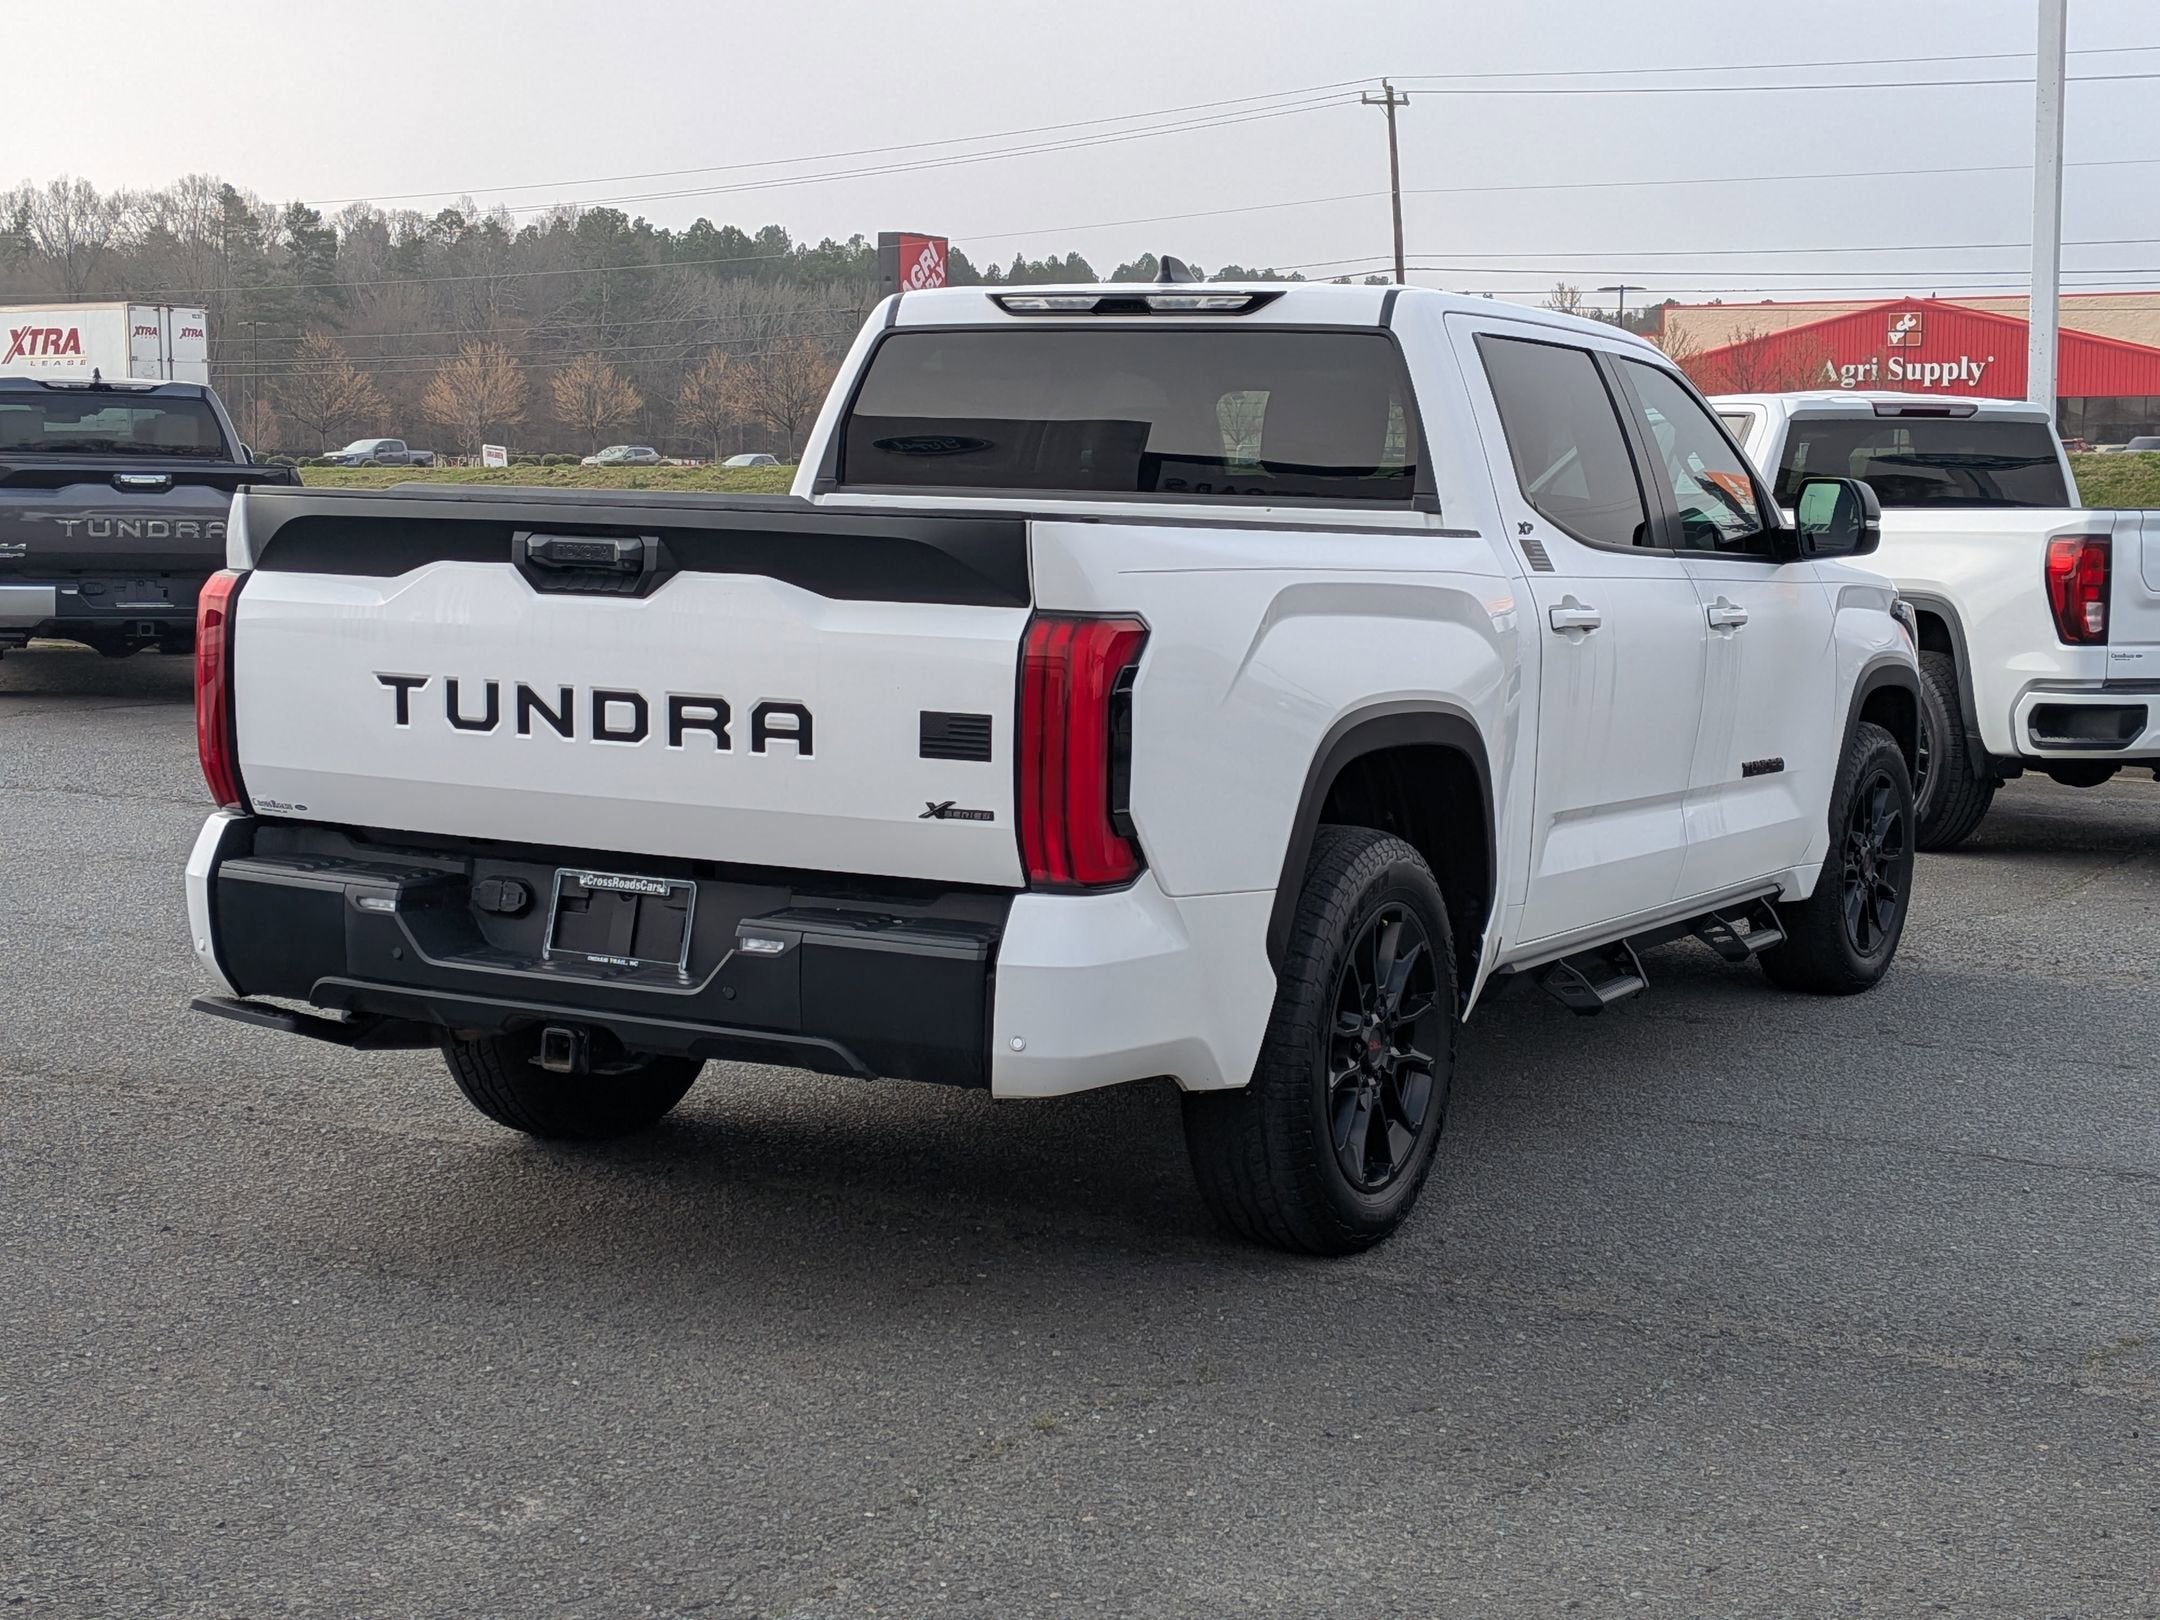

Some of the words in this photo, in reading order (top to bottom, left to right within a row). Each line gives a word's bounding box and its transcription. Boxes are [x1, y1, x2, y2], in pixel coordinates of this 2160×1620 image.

[132, 325, 158, 337] XTRA
[179, 327, 204, 339] XTRA
[1, 326, 81, 364] XTRA
[1818, 357, 1879, 388] Agri
[1888, 356, 1985, 387] Supply
[56, 518, 228, 539] TUNDRA
[373, 671, 815, 759] TUNDRA
